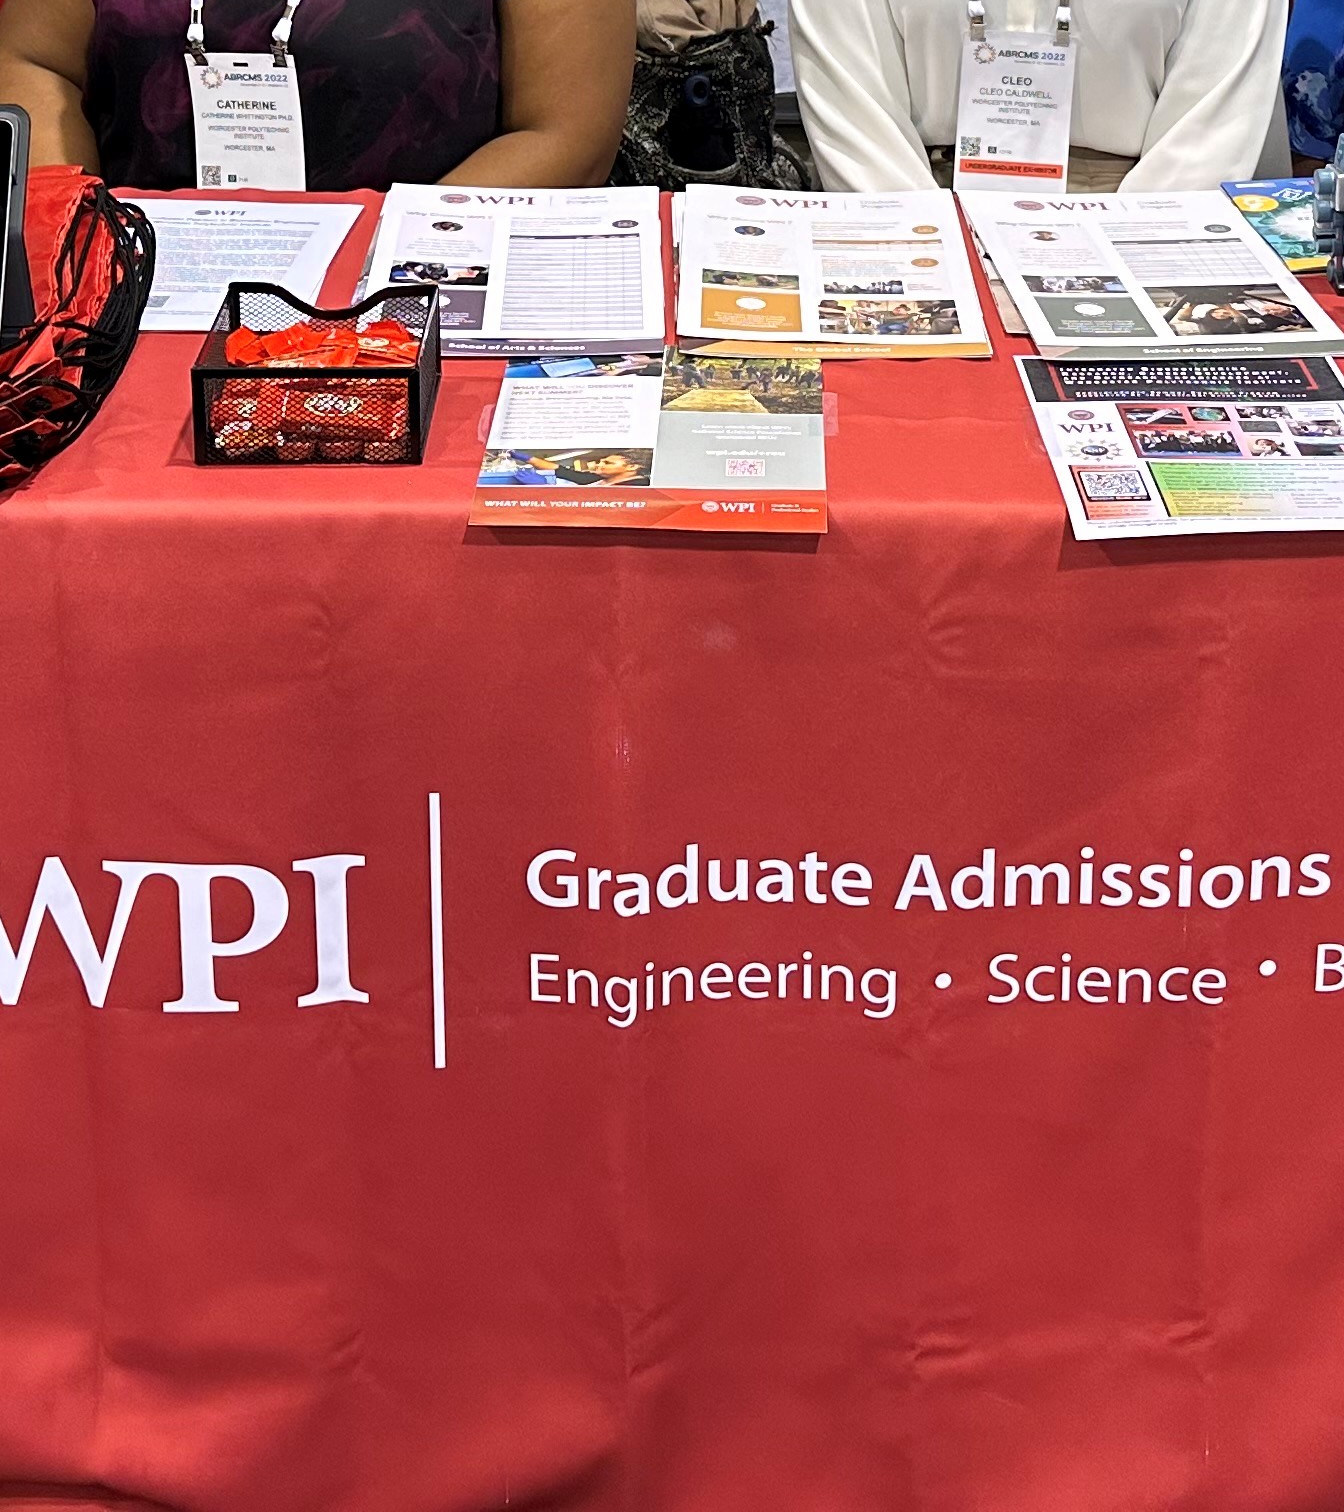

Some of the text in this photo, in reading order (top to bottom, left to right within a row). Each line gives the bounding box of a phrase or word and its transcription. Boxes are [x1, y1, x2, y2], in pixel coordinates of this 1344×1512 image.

[997, 49, 1066, 62] ABRCMS 2022
[223, 73, 289, 83] ABRCMS 2022
[1001, 75, 1033, 87] CLEO
[979, 87, 1053, 100] CLEO CALDWELL
[216, 99, 277, 111] CATHERINE
[476, 194, 537, 206] WPI
[770, 197, 829, 209] WPI
[1045, 201, 1110, 211] WPI
[448, 341, 487, 352] School
[488, 341, 500, 351] of
[501, 342, 525, 351] Arts
[537, 344, 586, 352] Sciences
[792, 346, 891, 354] The Global School
[1058, 423, 1115, 433] WPI
[484, 500, 518, 509] WHAT
[519, 500, 548, 509] WILL
[549, 500, 580, 509] YOUR
[580, 500, 624, 509] IMPACT
[719, 502, 756, 513] WPI
[525, 842, 1333, 918] Graduate Admissions
[527, 951, 899, 1029] Engineering
[985, 952, 1228, 1006] Science
